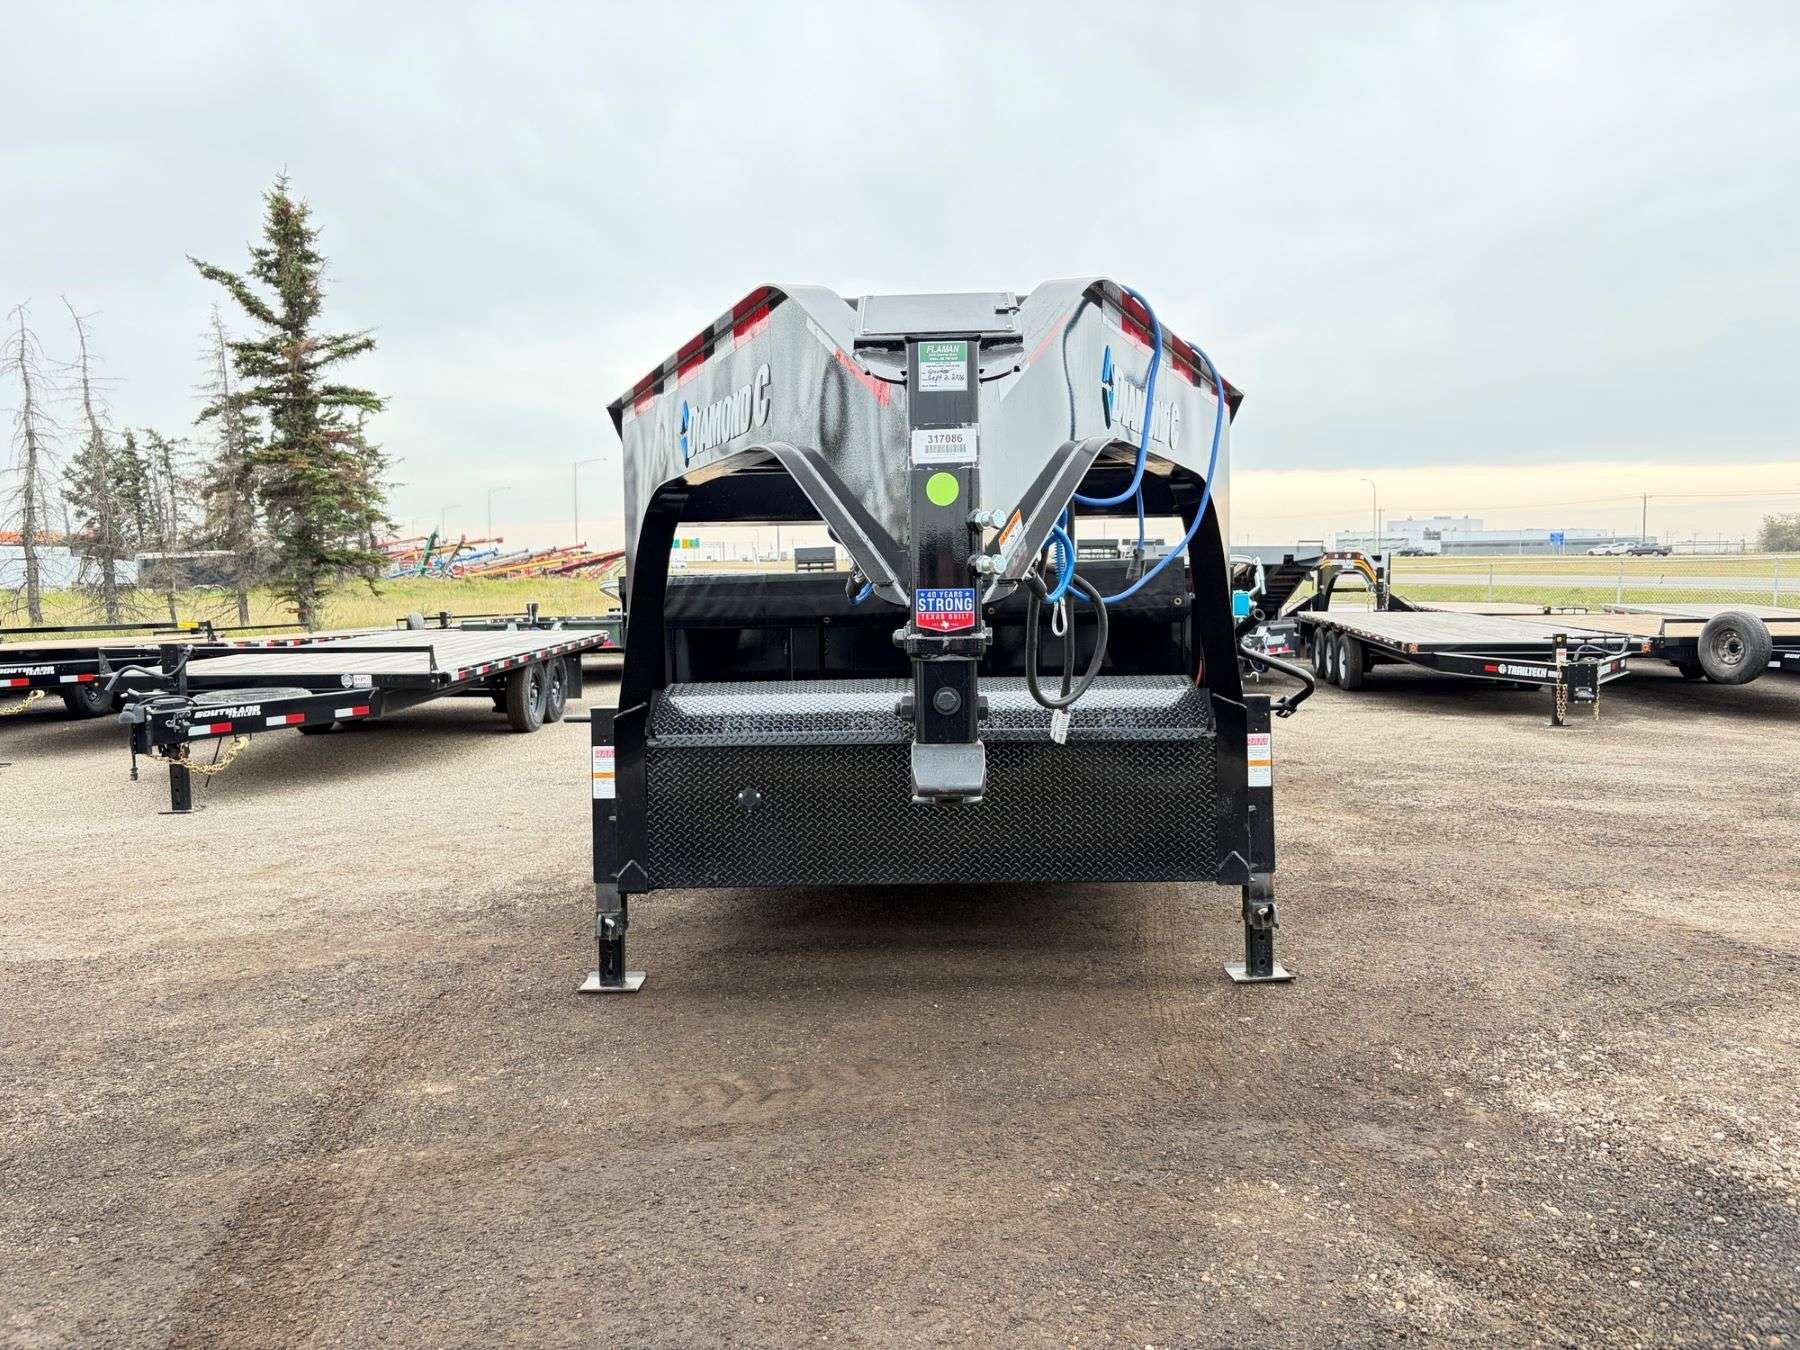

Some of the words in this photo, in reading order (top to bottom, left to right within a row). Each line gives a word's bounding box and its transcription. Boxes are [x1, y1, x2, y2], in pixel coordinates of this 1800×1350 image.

[926, 344, 960, 353] FLAMAN
[687, 384, 752, 460] DIAMOND
[753, 363, 771, 428] C
[927, 433, 963, 444] 317086
[918, 597, 973, 611] STRONG
[1507, 664, 1548, 678] TRAILTECH
[193, 704, 261, 718] SOUTHLAND
